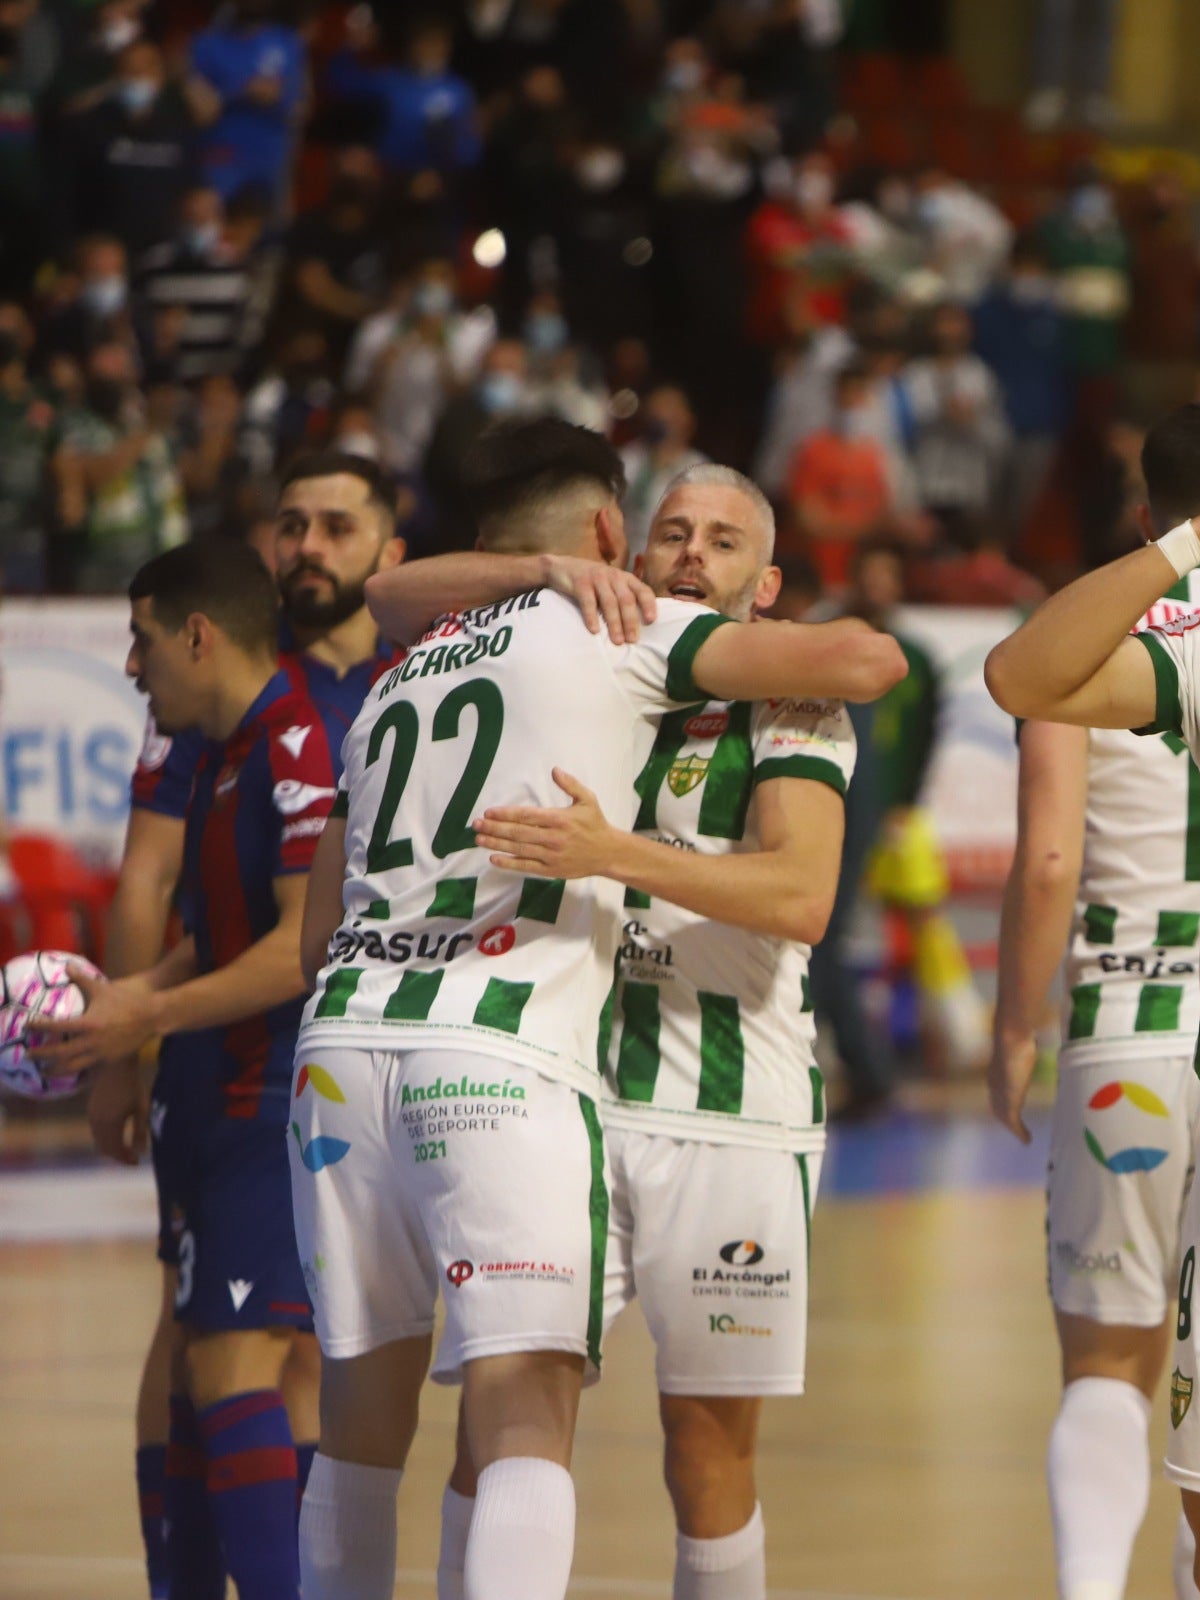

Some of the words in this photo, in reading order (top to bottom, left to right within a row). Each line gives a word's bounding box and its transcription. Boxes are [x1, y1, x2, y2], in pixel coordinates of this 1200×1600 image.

[378, 625, 513, 701] RICARDO
[365, 677, 505, 874] 22
[401, 1075, 526, 1107] Andalucía
[402, 1103, 448, 1124] REGIÓN
[454, 1103, 529, 1120] EUROPEA
[407, 1124, 424, 1139] DEL
[427, 1118, 501, 1135] DEPORTE
[414, 1140, 447, 1163] 2021
[692, 1268, 707, 1281] El
